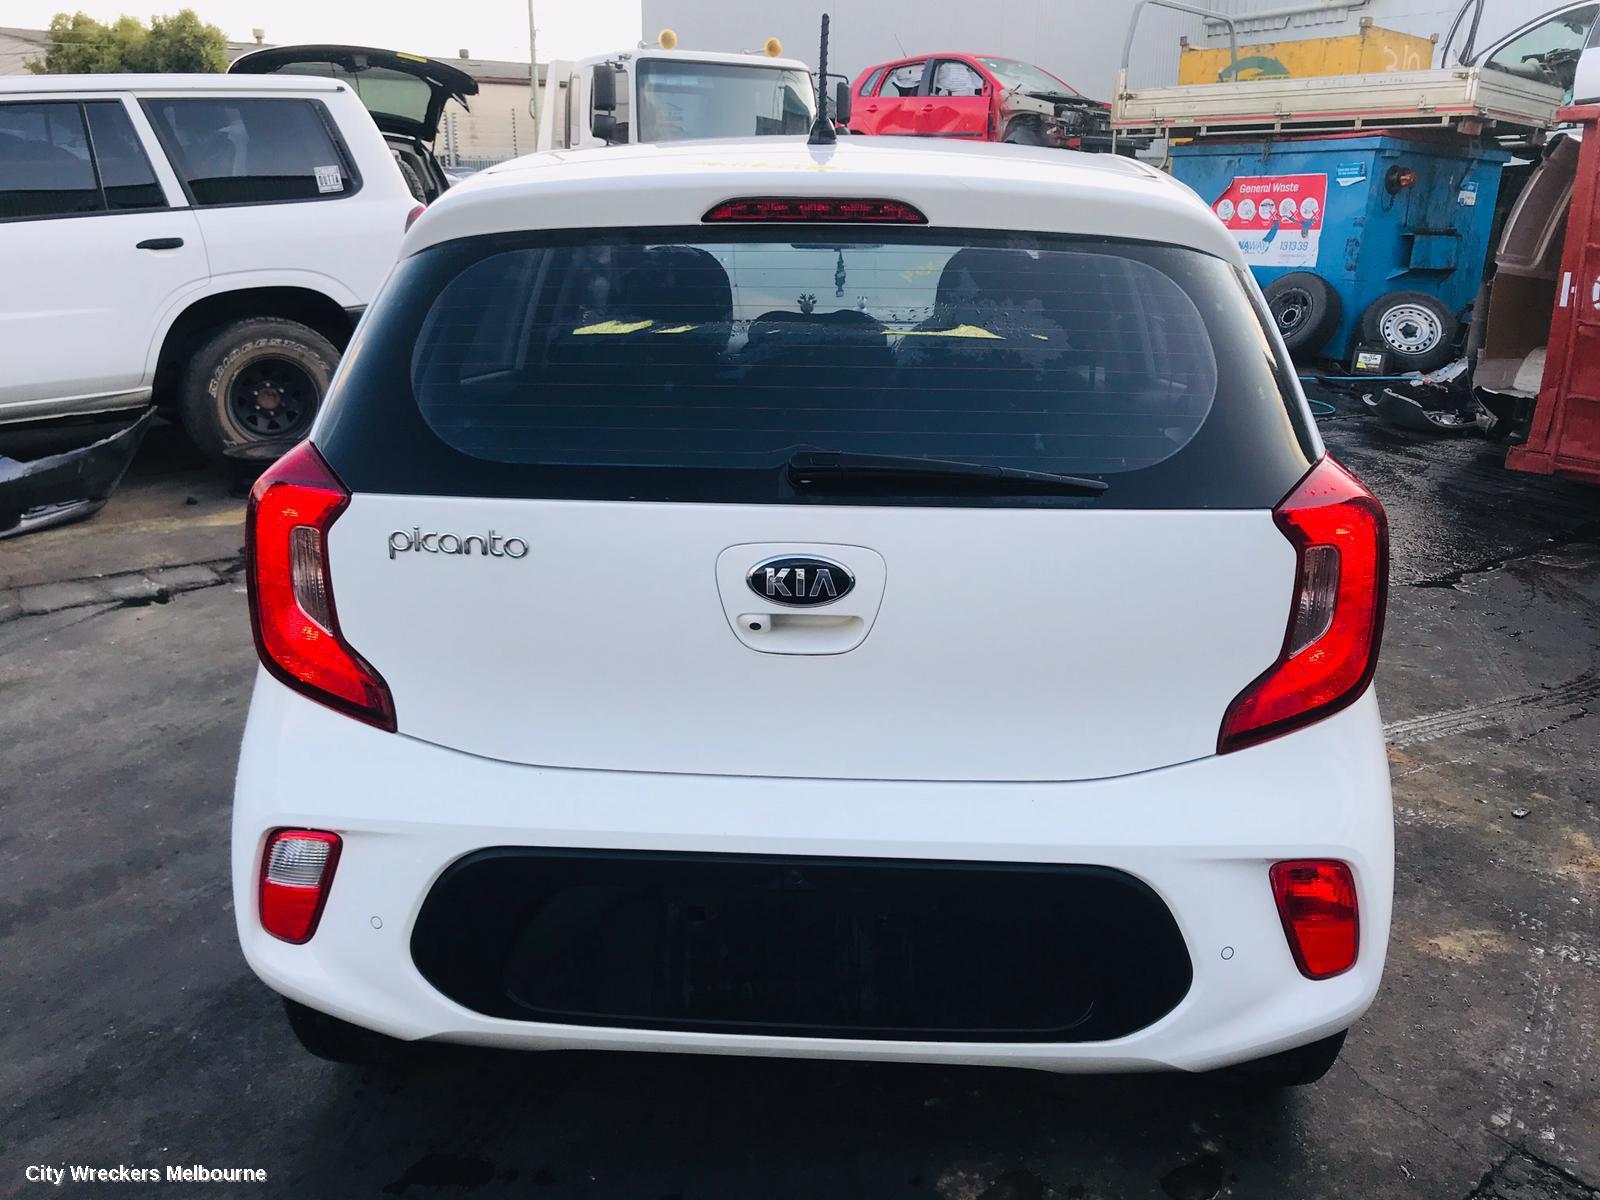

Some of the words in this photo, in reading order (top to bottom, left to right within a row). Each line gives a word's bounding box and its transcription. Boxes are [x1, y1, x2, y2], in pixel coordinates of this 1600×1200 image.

[1239, 183, 1271, 194] General
[1273, 182, 1299, 193] Waste
[388, 526, 530, 560] picanto
[764, 566, 838, 598] KIA
